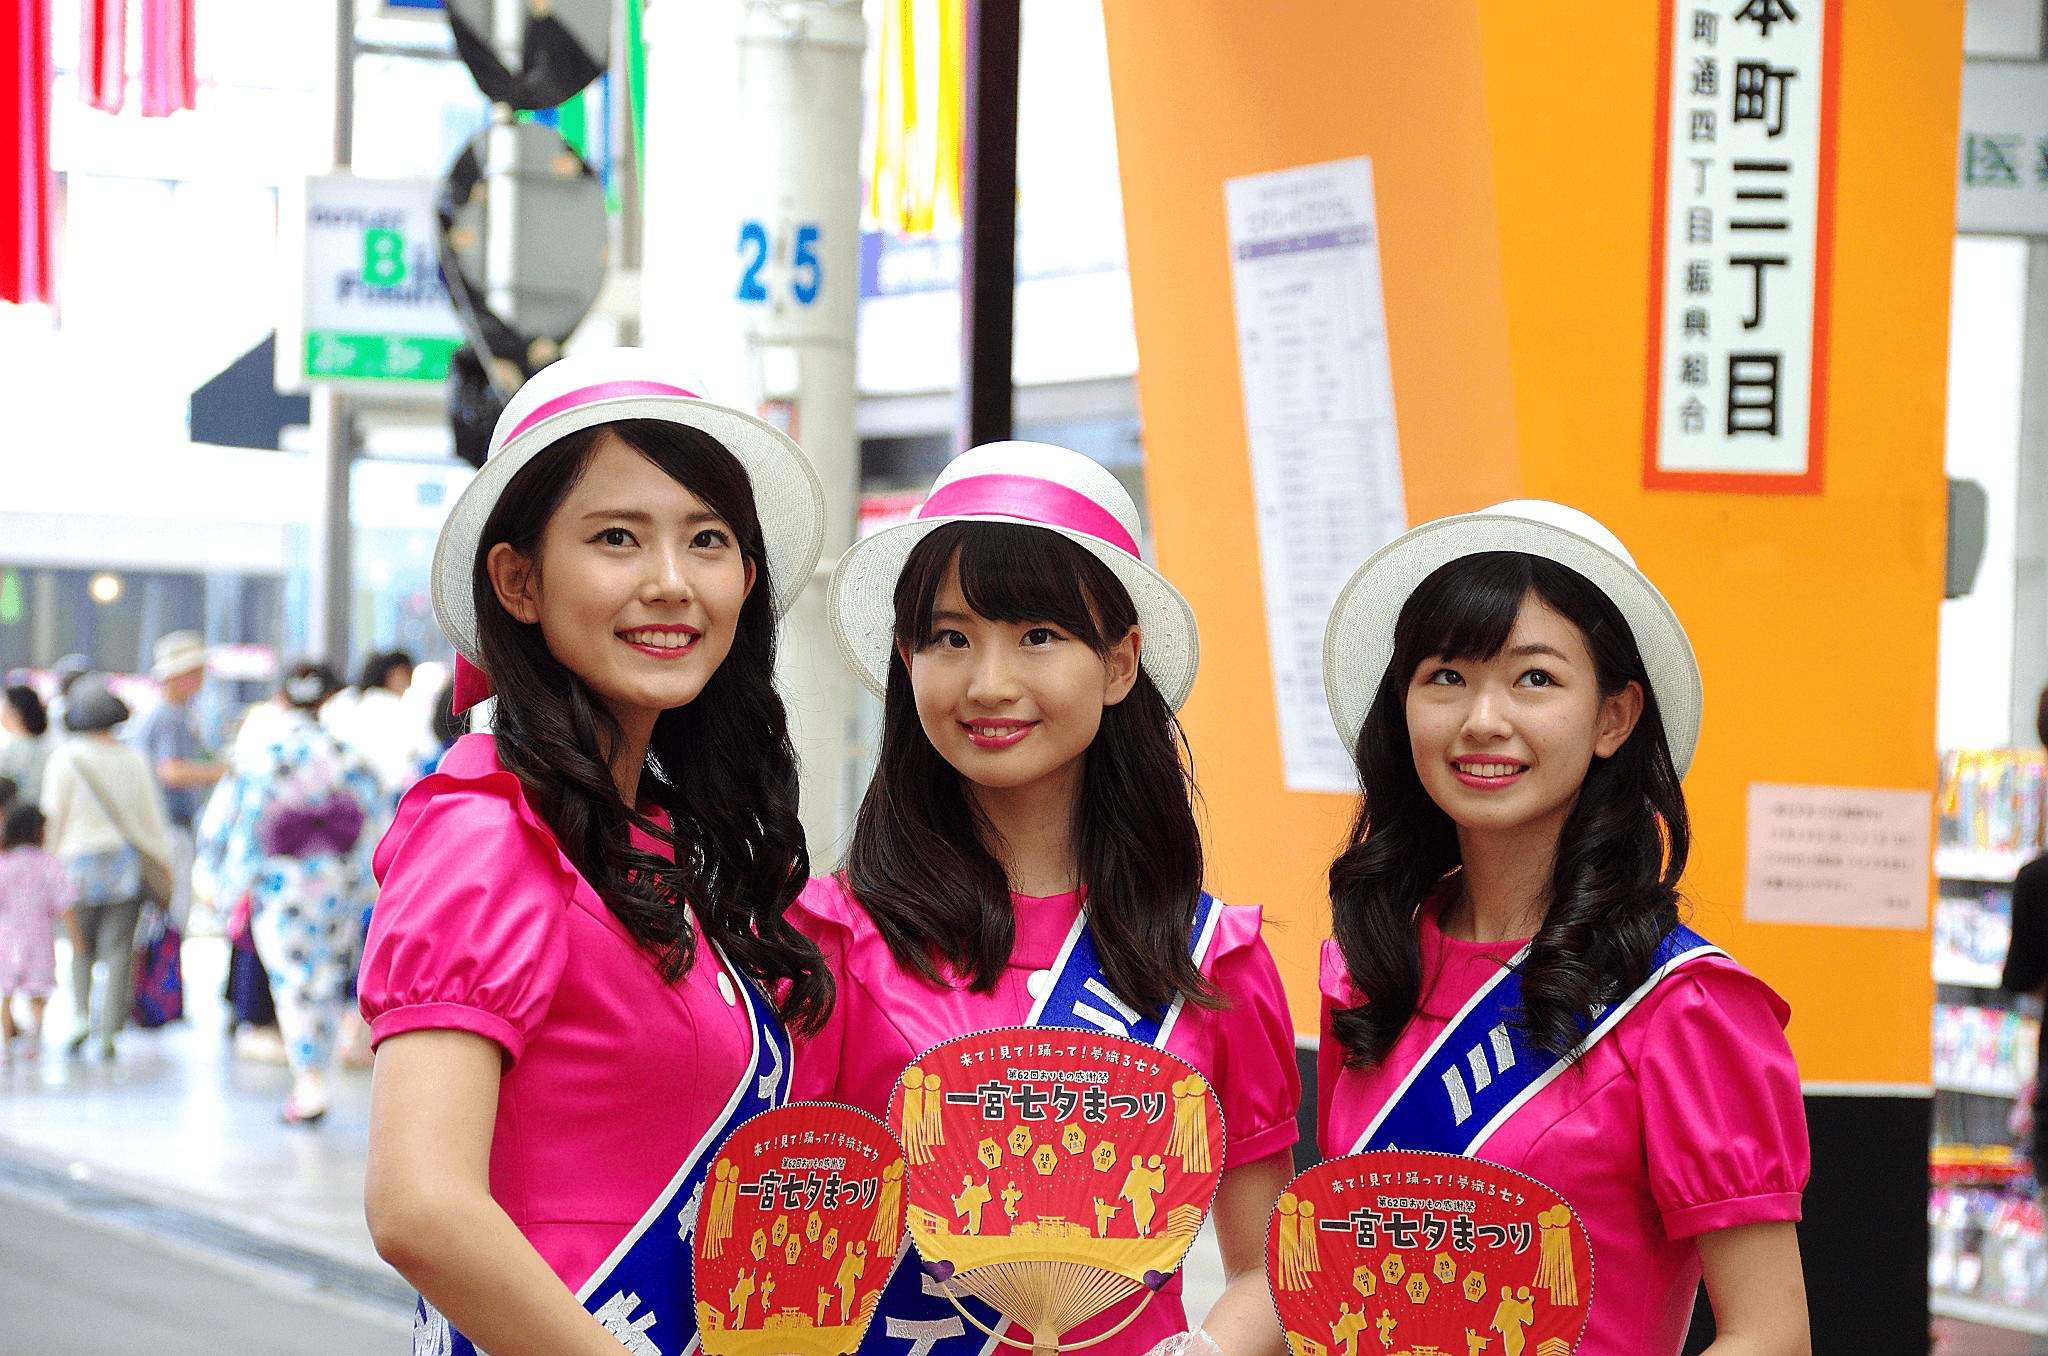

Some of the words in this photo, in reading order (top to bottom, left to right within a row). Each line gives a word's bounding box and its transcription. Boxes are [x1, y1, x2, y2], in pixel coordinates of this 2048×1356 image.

[1680, 8, 1718, 434] 町通四丁目振興組合
[946, 1080, 1166, 1124] 一宮七夕まつり
[739, 1169, 878, 1211] 一宮七夕まつり
[1320, 1207, 1532, 1254] 一宮七夕まつり
